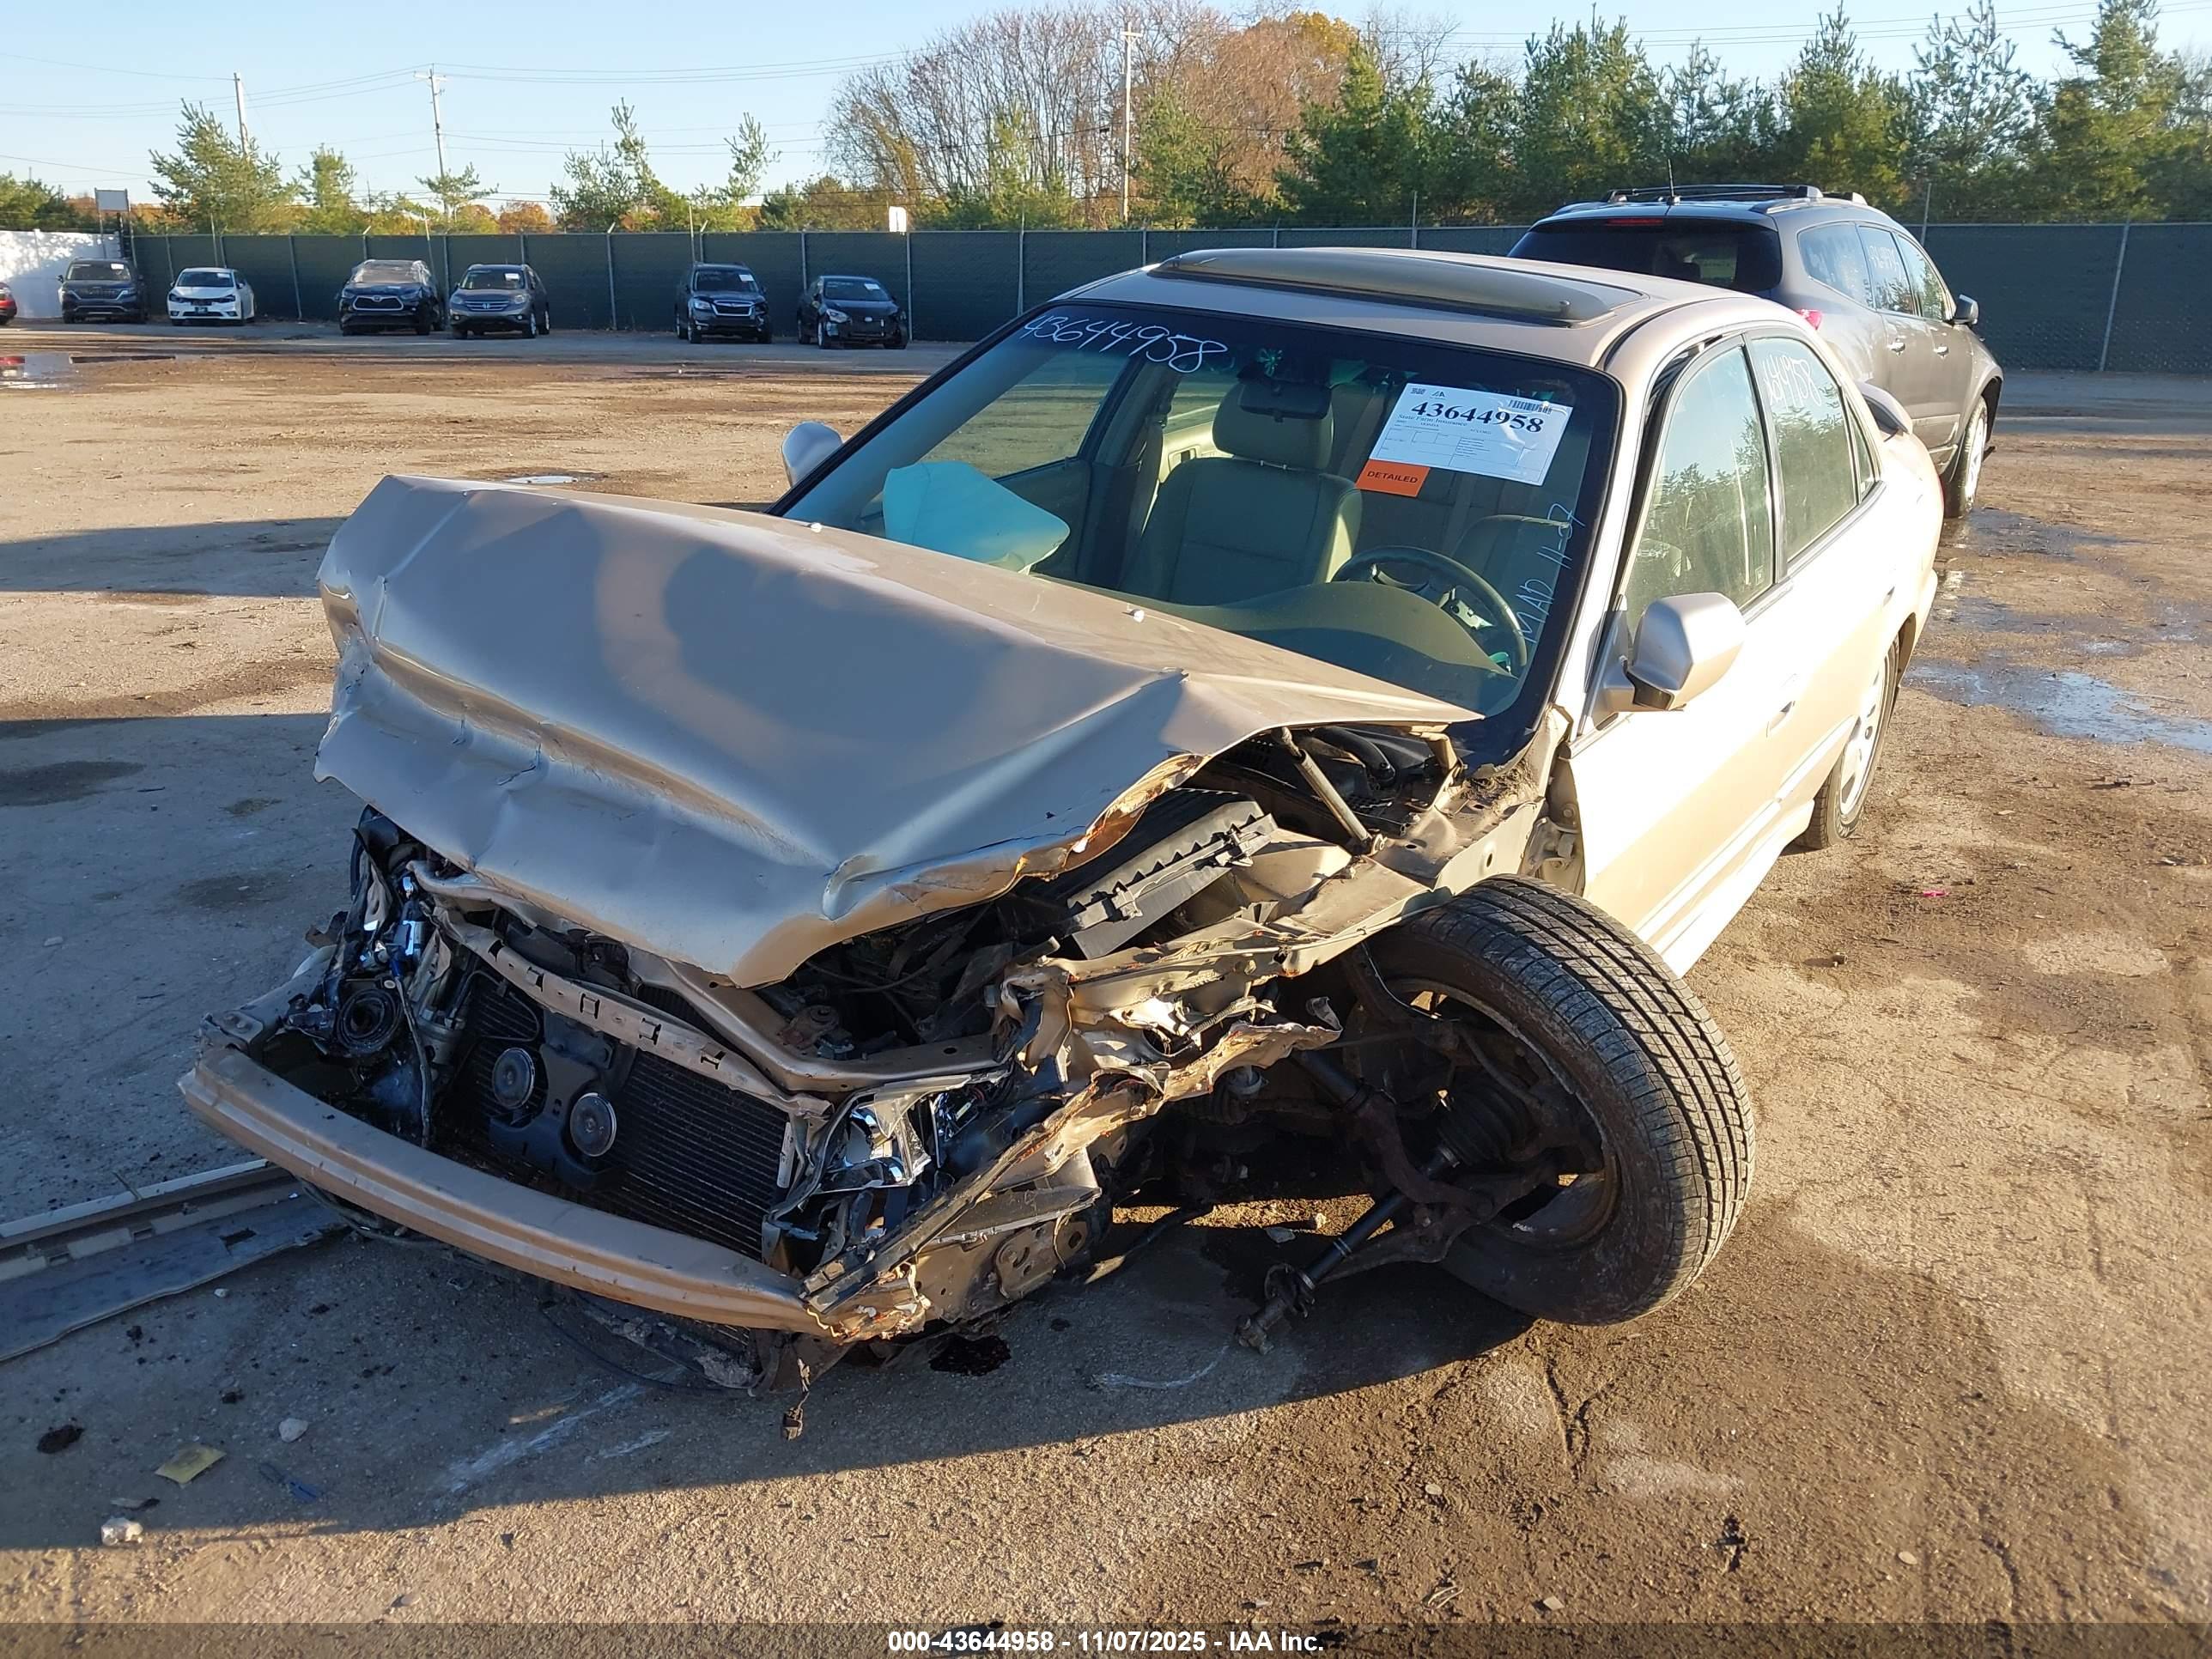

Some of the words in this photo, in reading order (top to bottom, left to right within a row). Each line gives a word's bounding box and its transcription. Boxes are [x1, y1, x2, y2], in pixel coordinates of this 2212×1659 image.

[1019, 314, 1228, 373] 43644958
[1411, 401, 1545, 433] 43644958
[1435, 417, 1468, 427] Insurance
[1366, 470, 1419, 484] DETAILED
